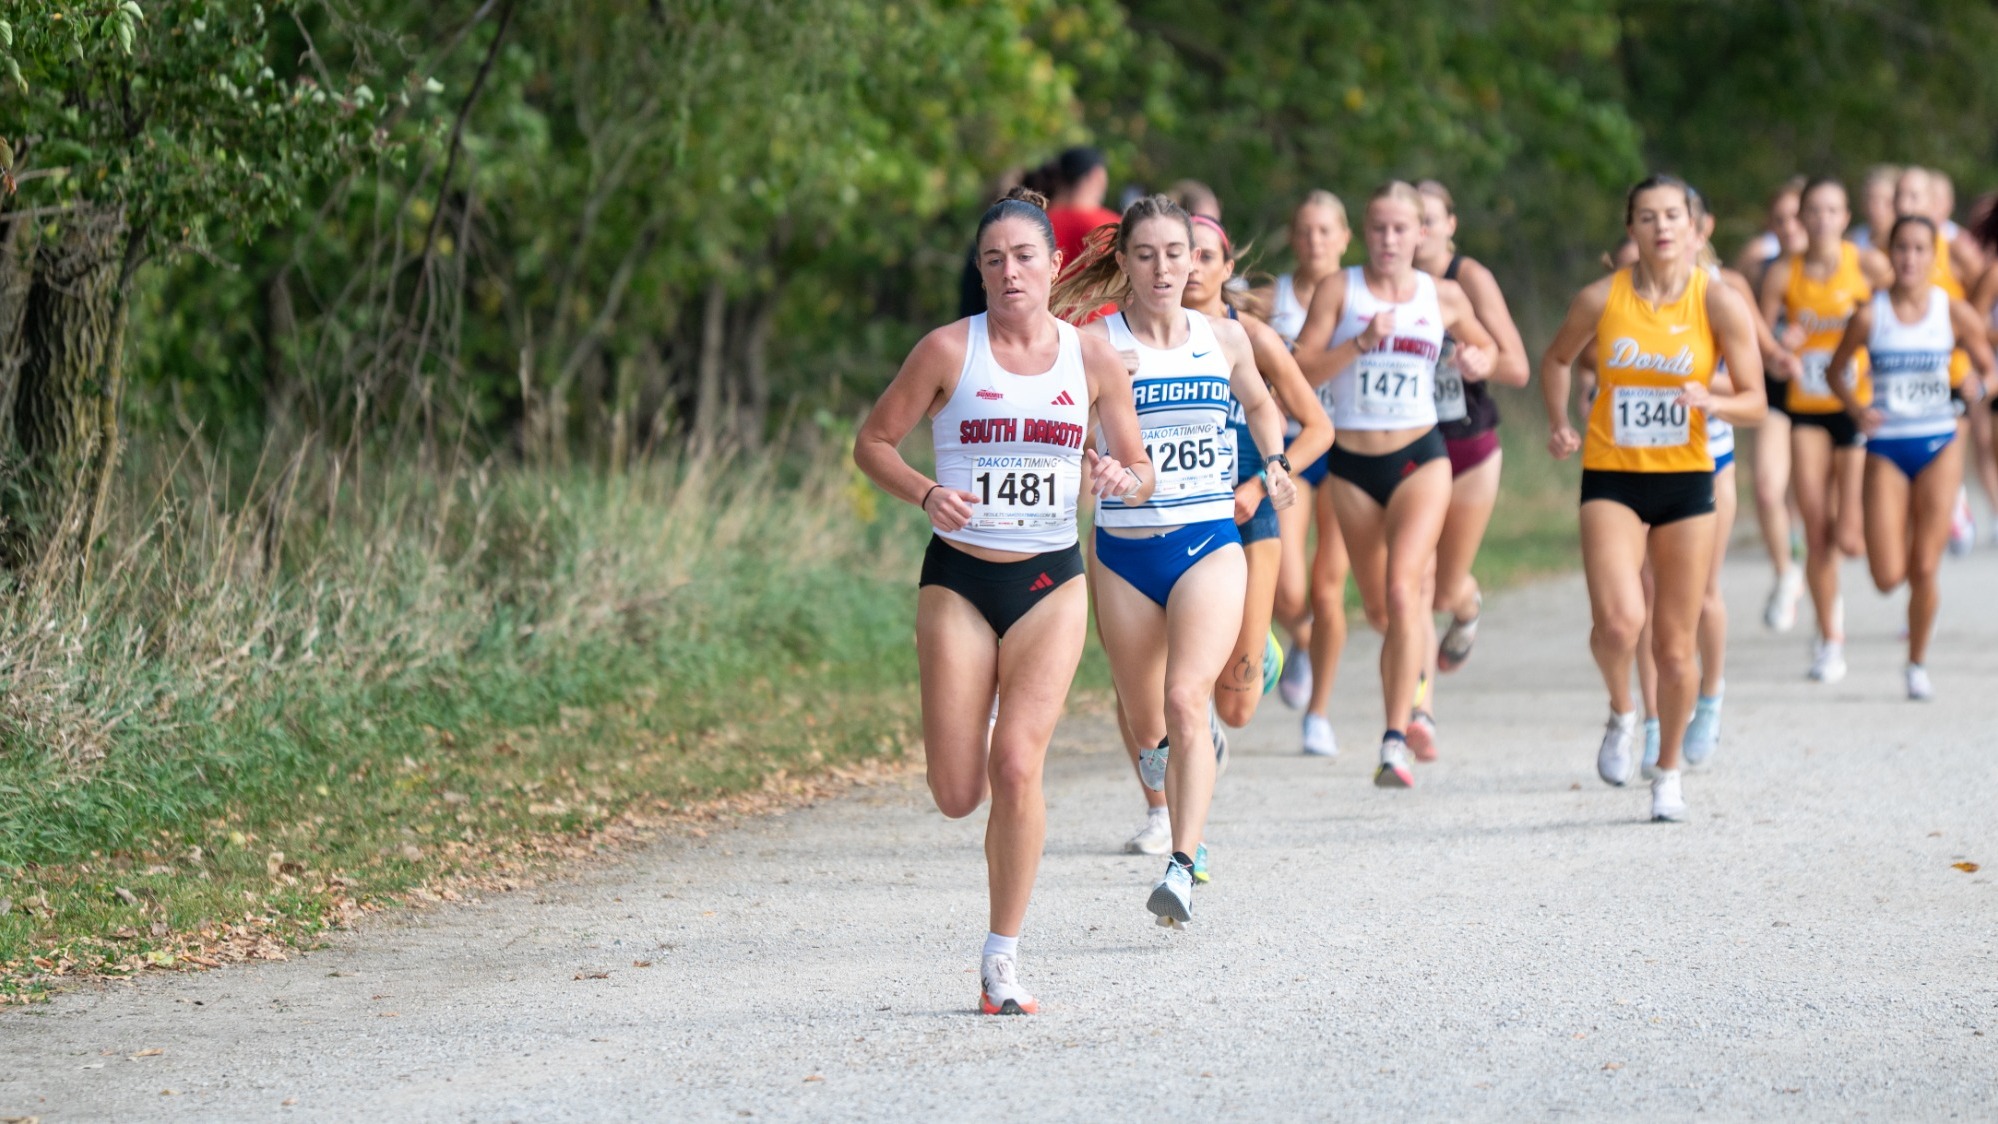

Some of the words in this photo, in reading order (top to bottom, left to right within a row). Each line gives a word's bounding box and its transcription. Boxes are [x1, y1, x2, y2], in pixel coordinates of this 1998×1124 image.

[1607, 337, 1695, 376] Dordt
[1133, 381, 1231, 404] REIGHTON
[1359, 371, 1419, 397] 1471
[1618, 401, 1687, 427] 1340
[960, 418, 1018, 444] SOUTH
[1023, 418, 1083, 450] DAKOTA
[977, 456, 1058, 468] DAKOTATIMING
[976, 472, 1056, 506] 1481
